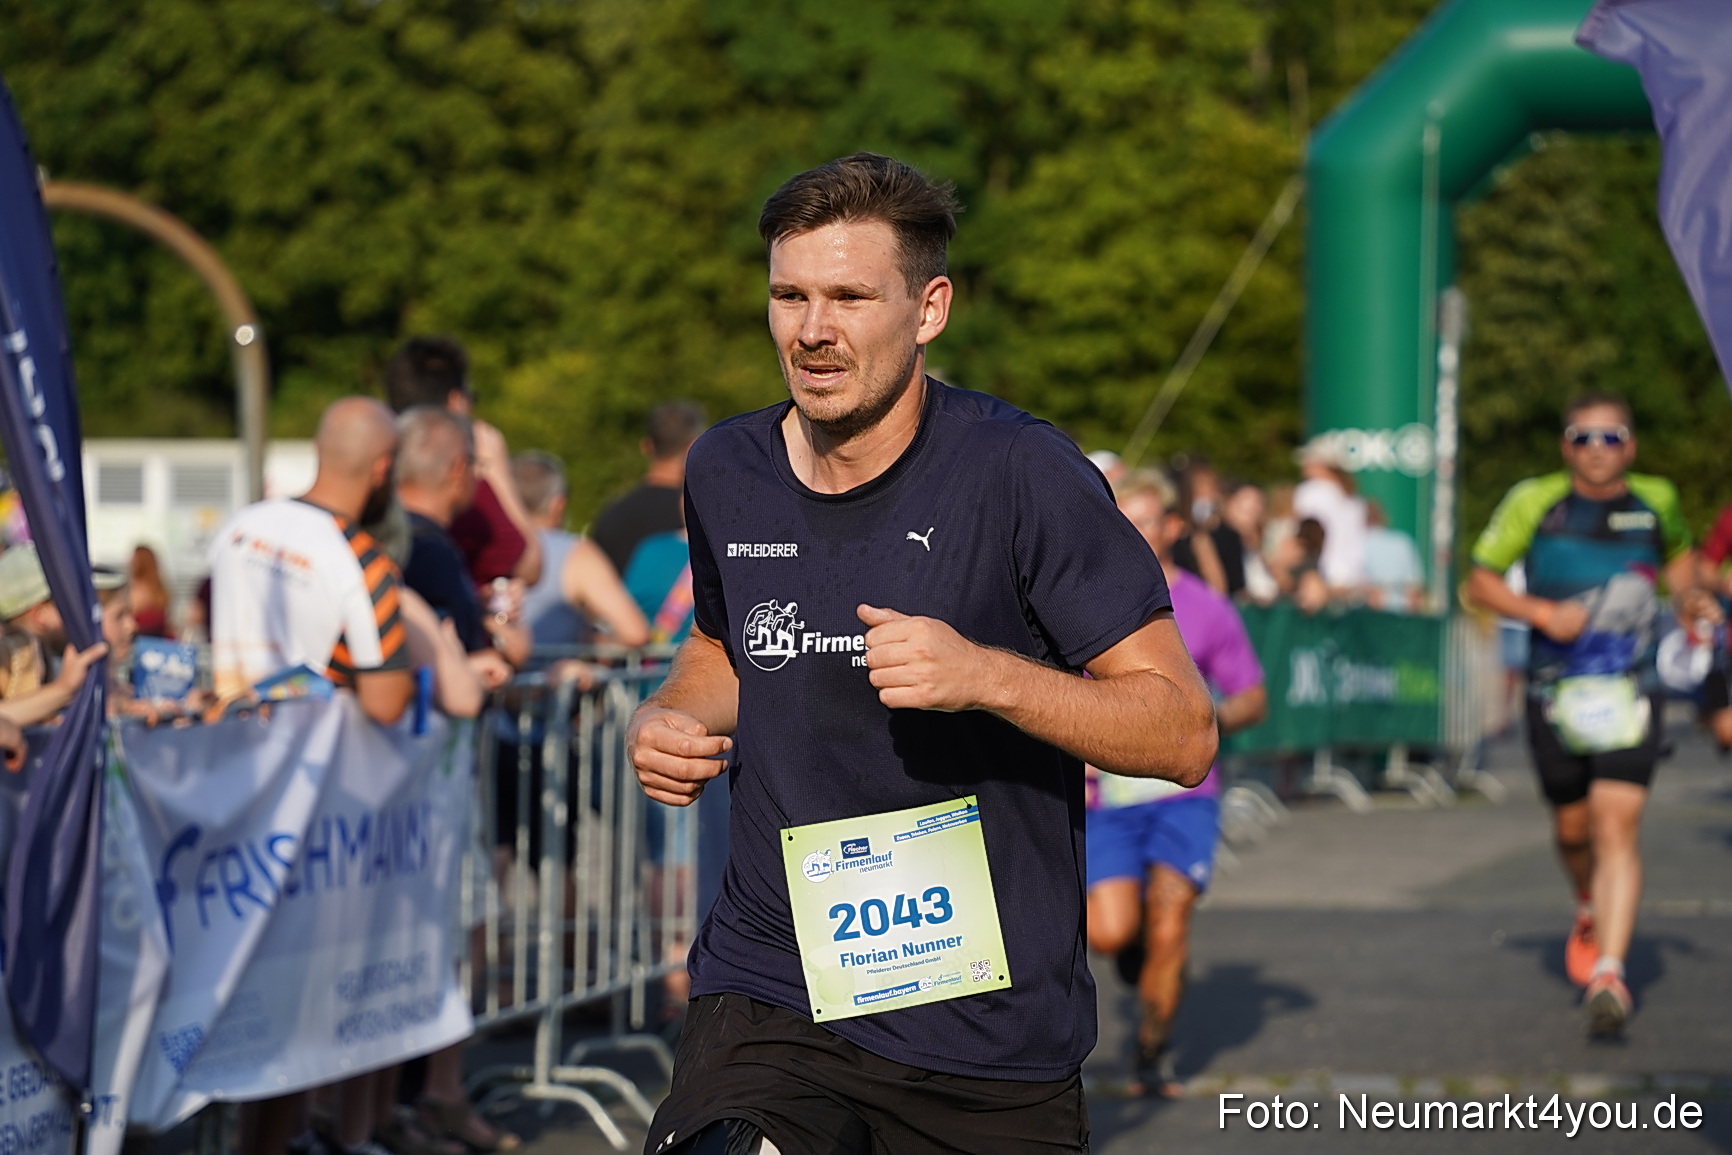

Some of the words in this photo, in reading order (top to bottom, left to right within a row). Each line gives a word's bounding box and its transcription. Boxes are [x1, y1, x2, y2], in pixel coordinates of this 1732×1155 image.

[738, 543, 798, 557] PFLEIDERER
[802, 632, 869, 654] Firme
[835, 850, 893, 871] Firmenlauf
[859, 860, 894, 873] neumarkt
[829, 886, 953, 942] 2043
[840, 949, 898, 968] Florian
[902, 935, 963, 958] Nunner
[866, 966, 892, 975] Pfleiderer
[892, 960, 925, 971] Deutschland
[925, 956, 942, 964] GmbH
[933, 974, 962, 987] Firmenlauf
[856, 984, 917, 1004] firmenlauf.bayern
